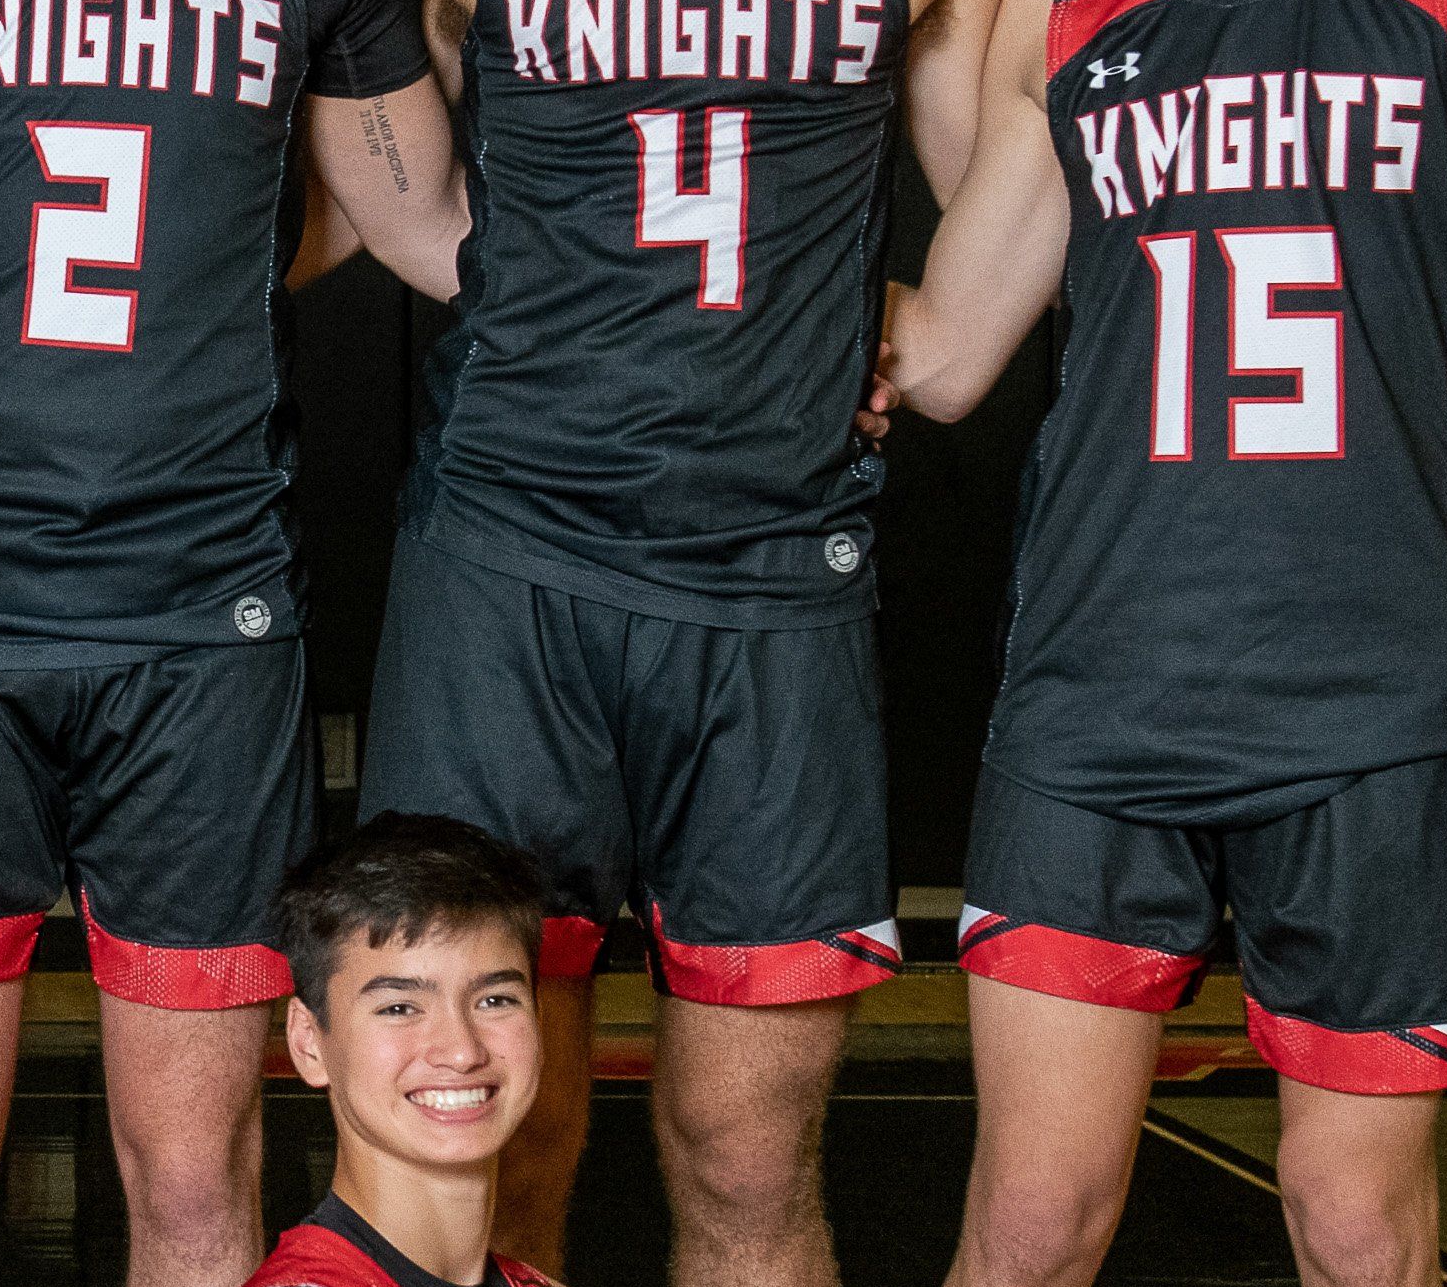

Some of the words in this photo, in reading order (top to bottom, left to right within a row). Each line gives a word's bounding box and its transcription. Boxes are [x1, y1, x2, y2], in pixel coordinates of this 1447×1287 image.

[376, 114, 395, 142] AMOR
[385, 142, 409, 194] DISCIPLINA
[627, 108, 752, 311] 4
[20, 120, 152, 352] 2
[1137, 225, 1346, 462] 15
